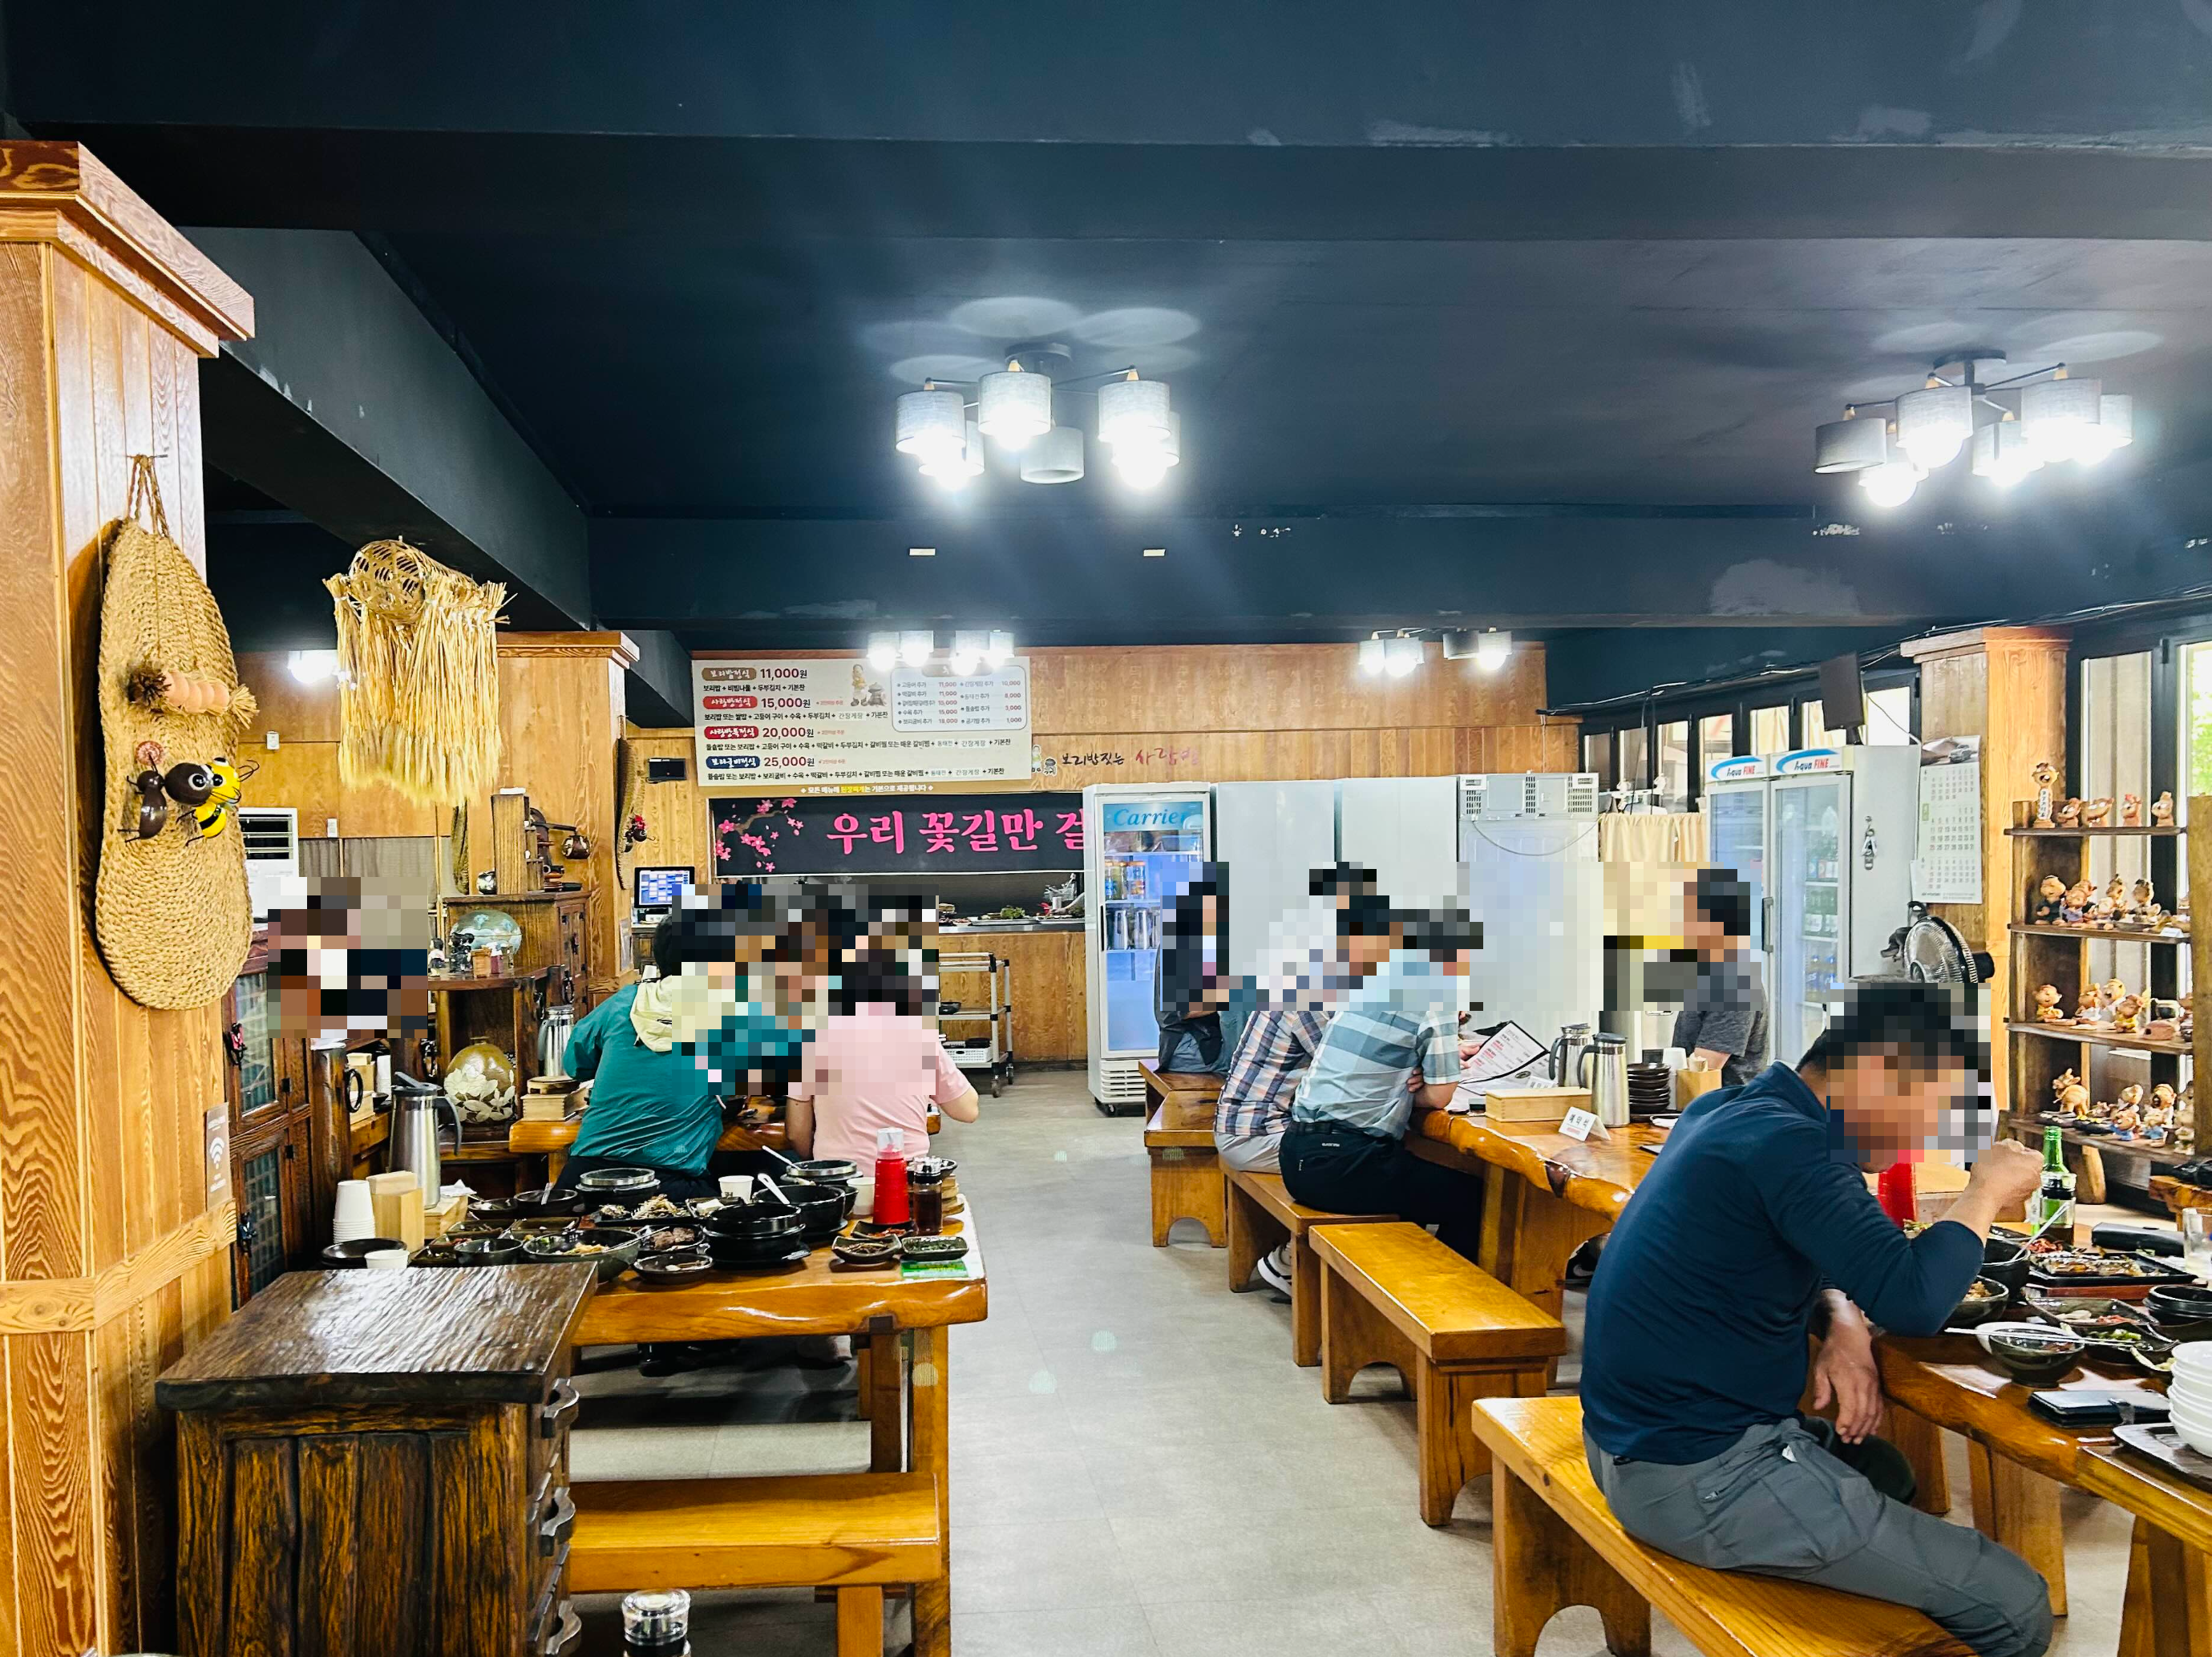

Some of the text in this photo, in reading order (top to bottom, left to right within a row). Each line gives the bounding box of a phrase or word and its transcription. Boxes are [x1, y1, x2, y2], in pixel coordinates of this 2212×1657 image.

[710, 669, 807, 681] 보리밥정식 11,000원
[711, 697, 751, 707] 사랑방정식
[761, 697, 811, 710] 15,000원
[762, 727, 815, 740] 20,000원
[711, 757, 757, 768] 보리굴비정식
[764, 757, 815, 769] 25,000원
[1062, 752, 1125, 766] 보리밥짓는
[1814, 758, 1830, 769] FINE
[1743, 766, 1756, 775] FINE
[896, 784, 927, 792] 제공됩니다
[827, 810, 904, 855] 우리
[919, 808, 1043, 854] 꽃길만
